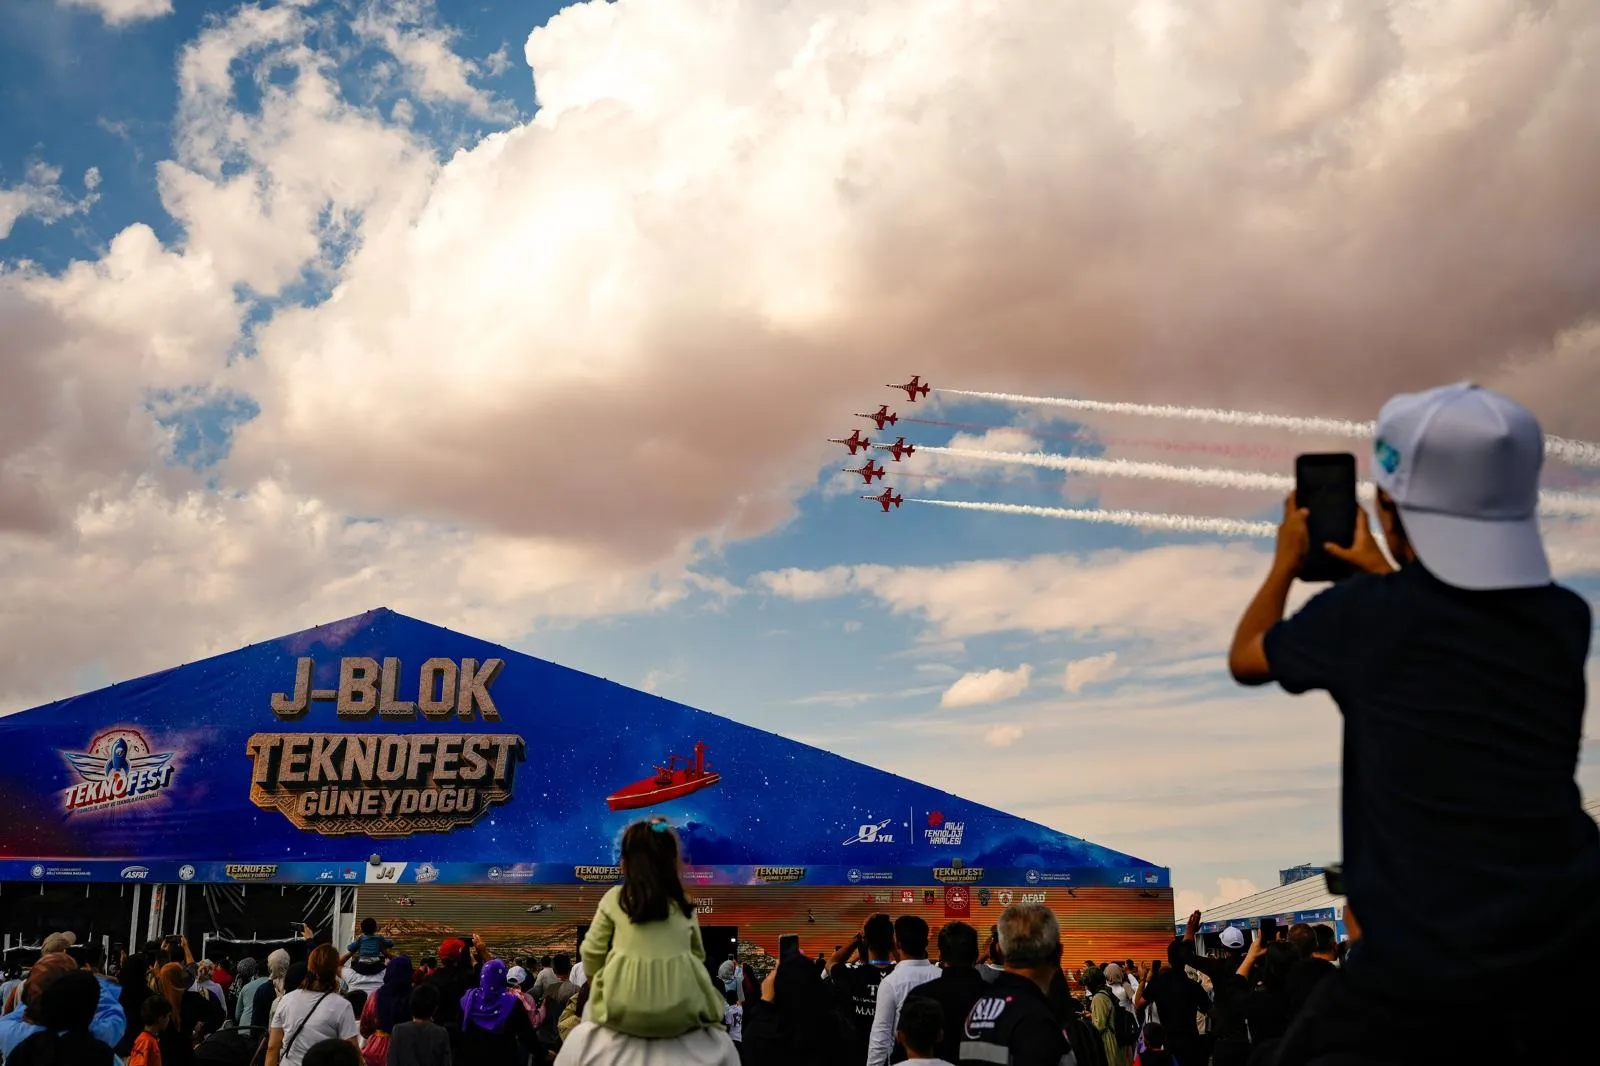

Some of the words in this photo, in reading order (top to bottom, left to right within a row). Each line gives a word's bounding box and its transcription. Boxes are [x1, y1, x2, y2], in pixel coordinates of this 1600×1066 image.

[270, 656, 504, 720] J-BLOK
[251, 734, 521, 790] TEKNOFEST
[64, 765, 175, 810] TEKNOFEST
[299, 784, 478, 819] GÜNEYDOĞU
[924, 829, 963, 838] TEKNOLOJİ
[929, 837, 962, 845] HAMLESİ
[226, 864, 277, 873] TEKNOFEST
[375, 866, 396, 880] J4
[754, 866, 804, 876] TEKNOFEST
[932, 867, 984, 877] TEKNOFEST
[124, 871, 149, 880] ASFAT
[1021, 892, 1046, 903] AFAD
